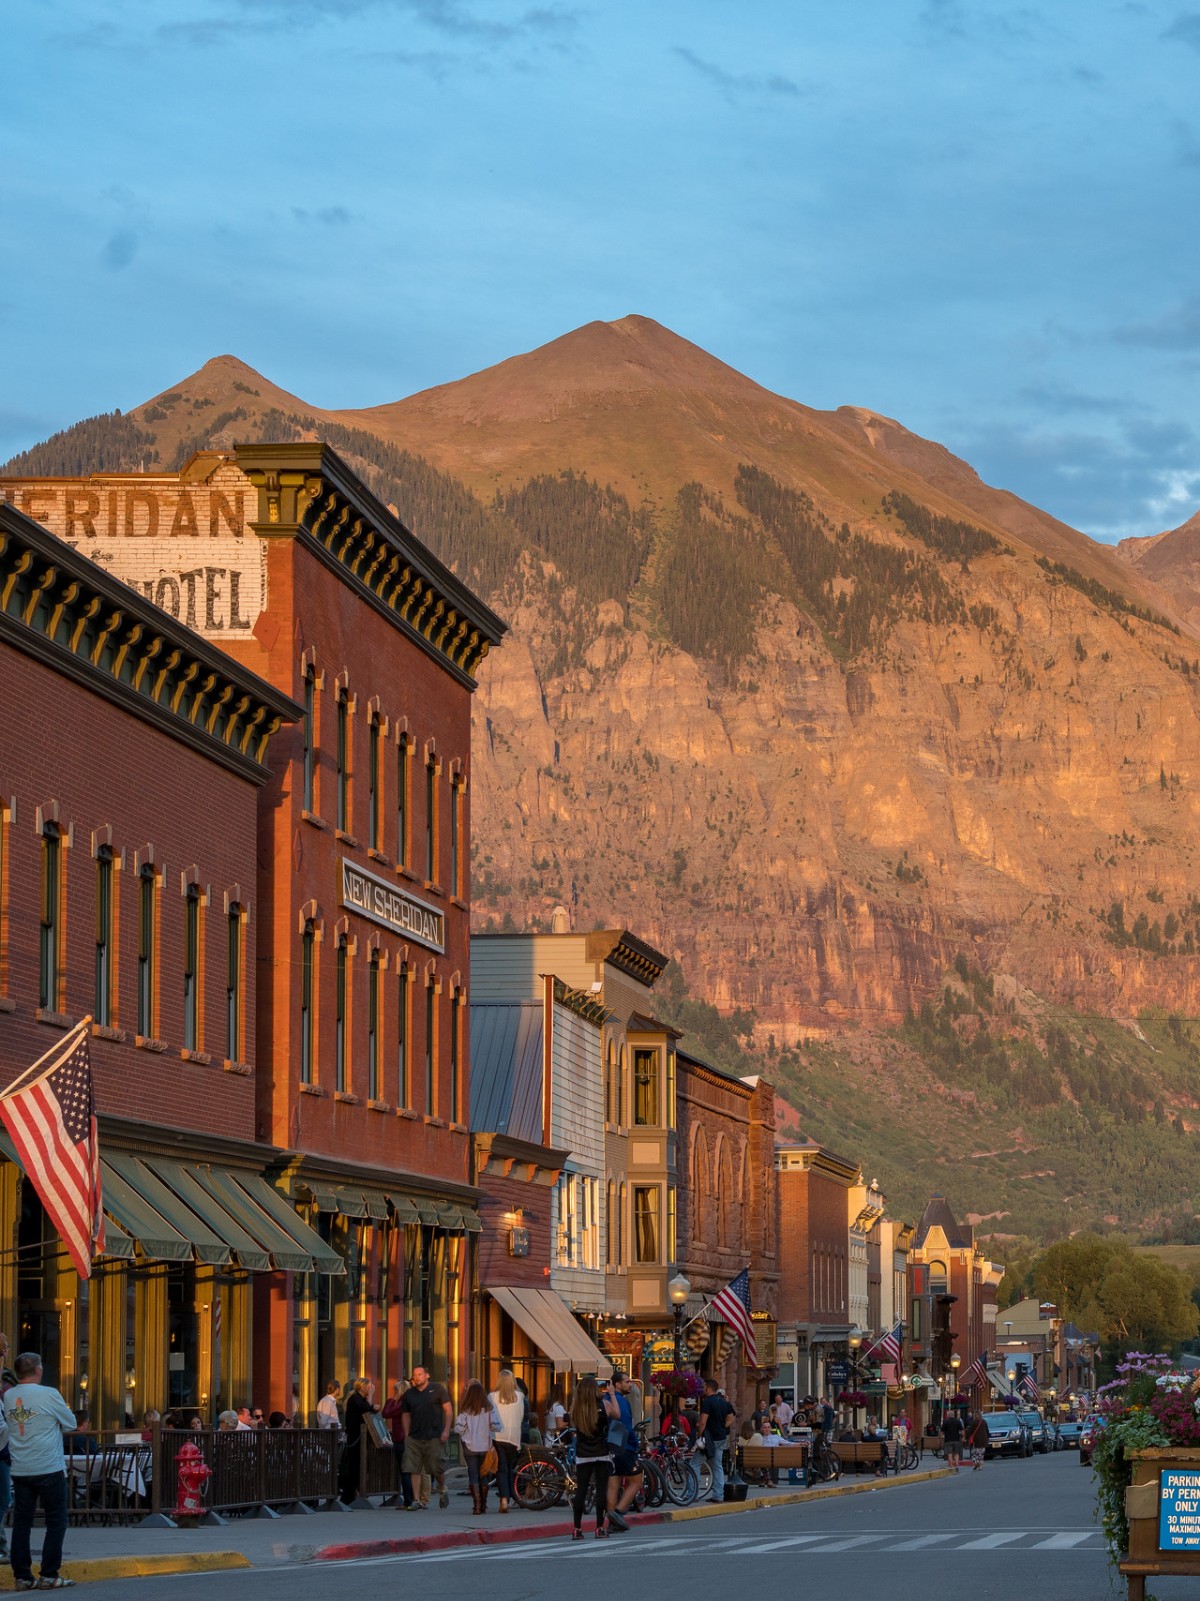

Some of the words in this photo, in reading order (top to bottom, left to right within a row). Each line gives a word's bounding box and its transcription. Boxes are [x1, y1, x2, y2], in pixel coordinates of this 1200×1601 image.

[5, 489, 245, 538] ERIDAN
[345, 871, 372, 910] NEW
[374, 886, 439, 944] SHERIDAN
[1162, 1488, 1175, 1499] BY
[1175, 1501, 1198, 1512] ONLY
[1167, 1515, 1178, 1524] 30
